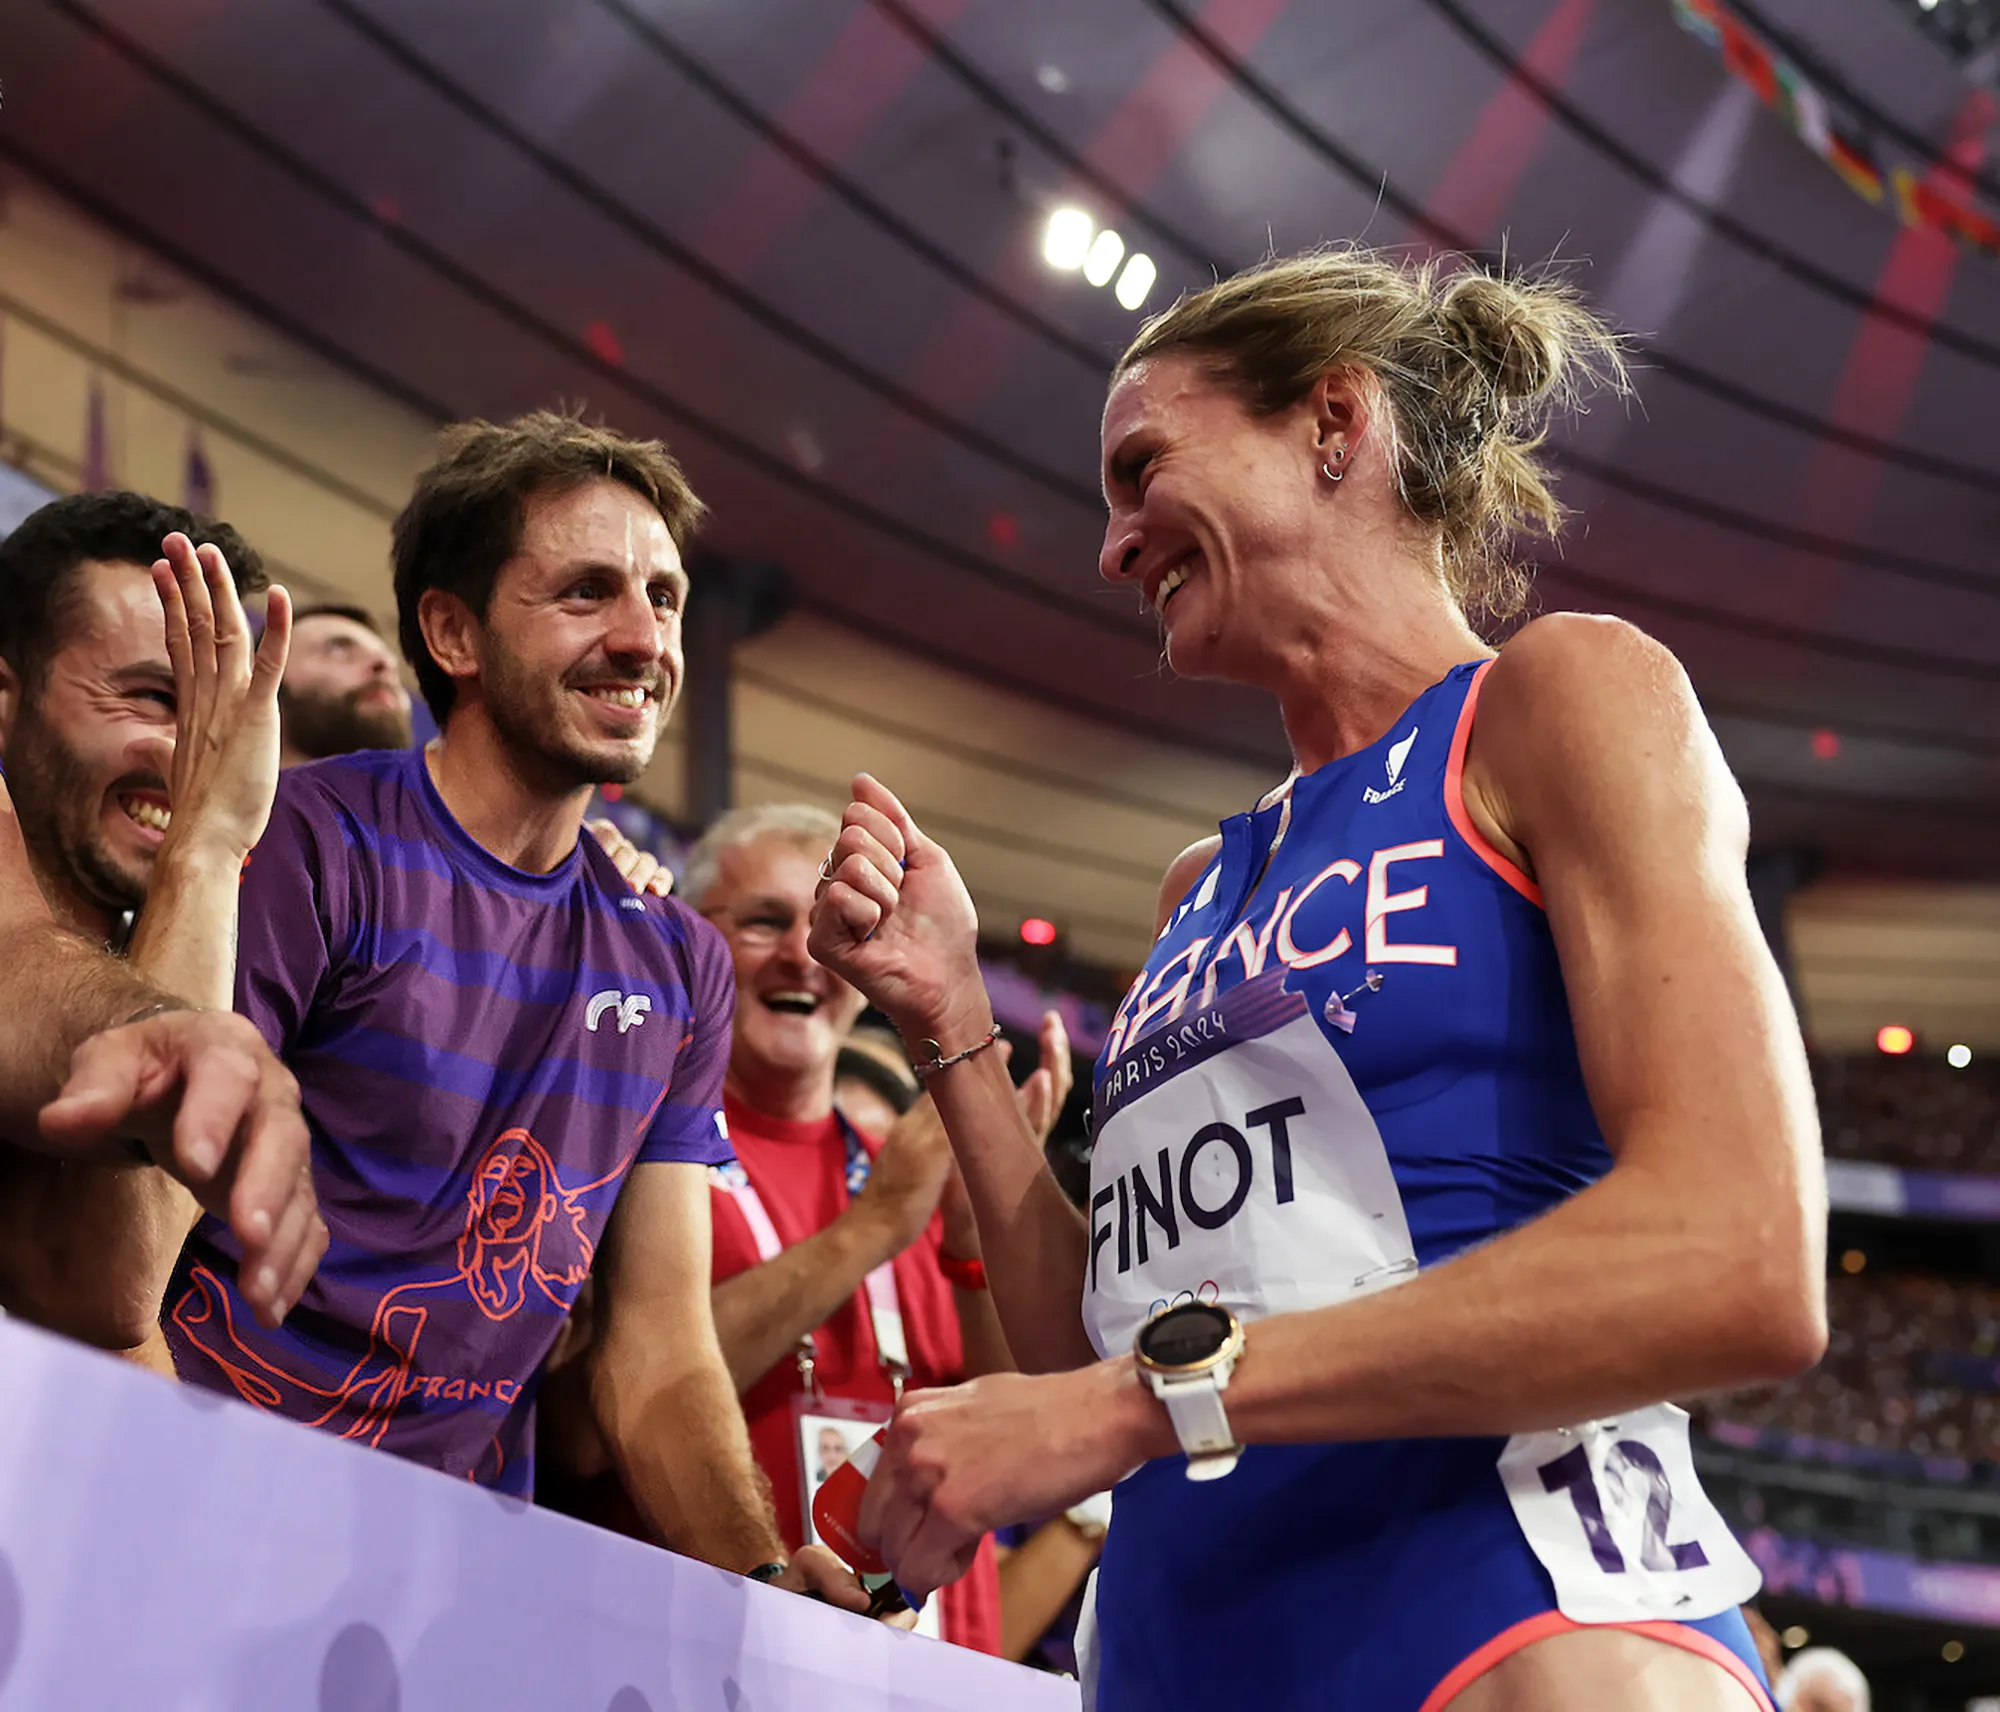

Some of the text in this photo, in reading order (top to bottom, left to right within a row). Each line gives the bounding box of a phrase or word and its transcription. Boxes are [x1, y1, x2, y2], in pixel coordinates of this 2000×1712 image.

[1166, 1010, 1226, 1061] 2024
[1091, 1096, 1306, 1293] FINOT
[402, 1375, 523, 1404] FRANC
[1536, 1441, 1711, 1574] 12
